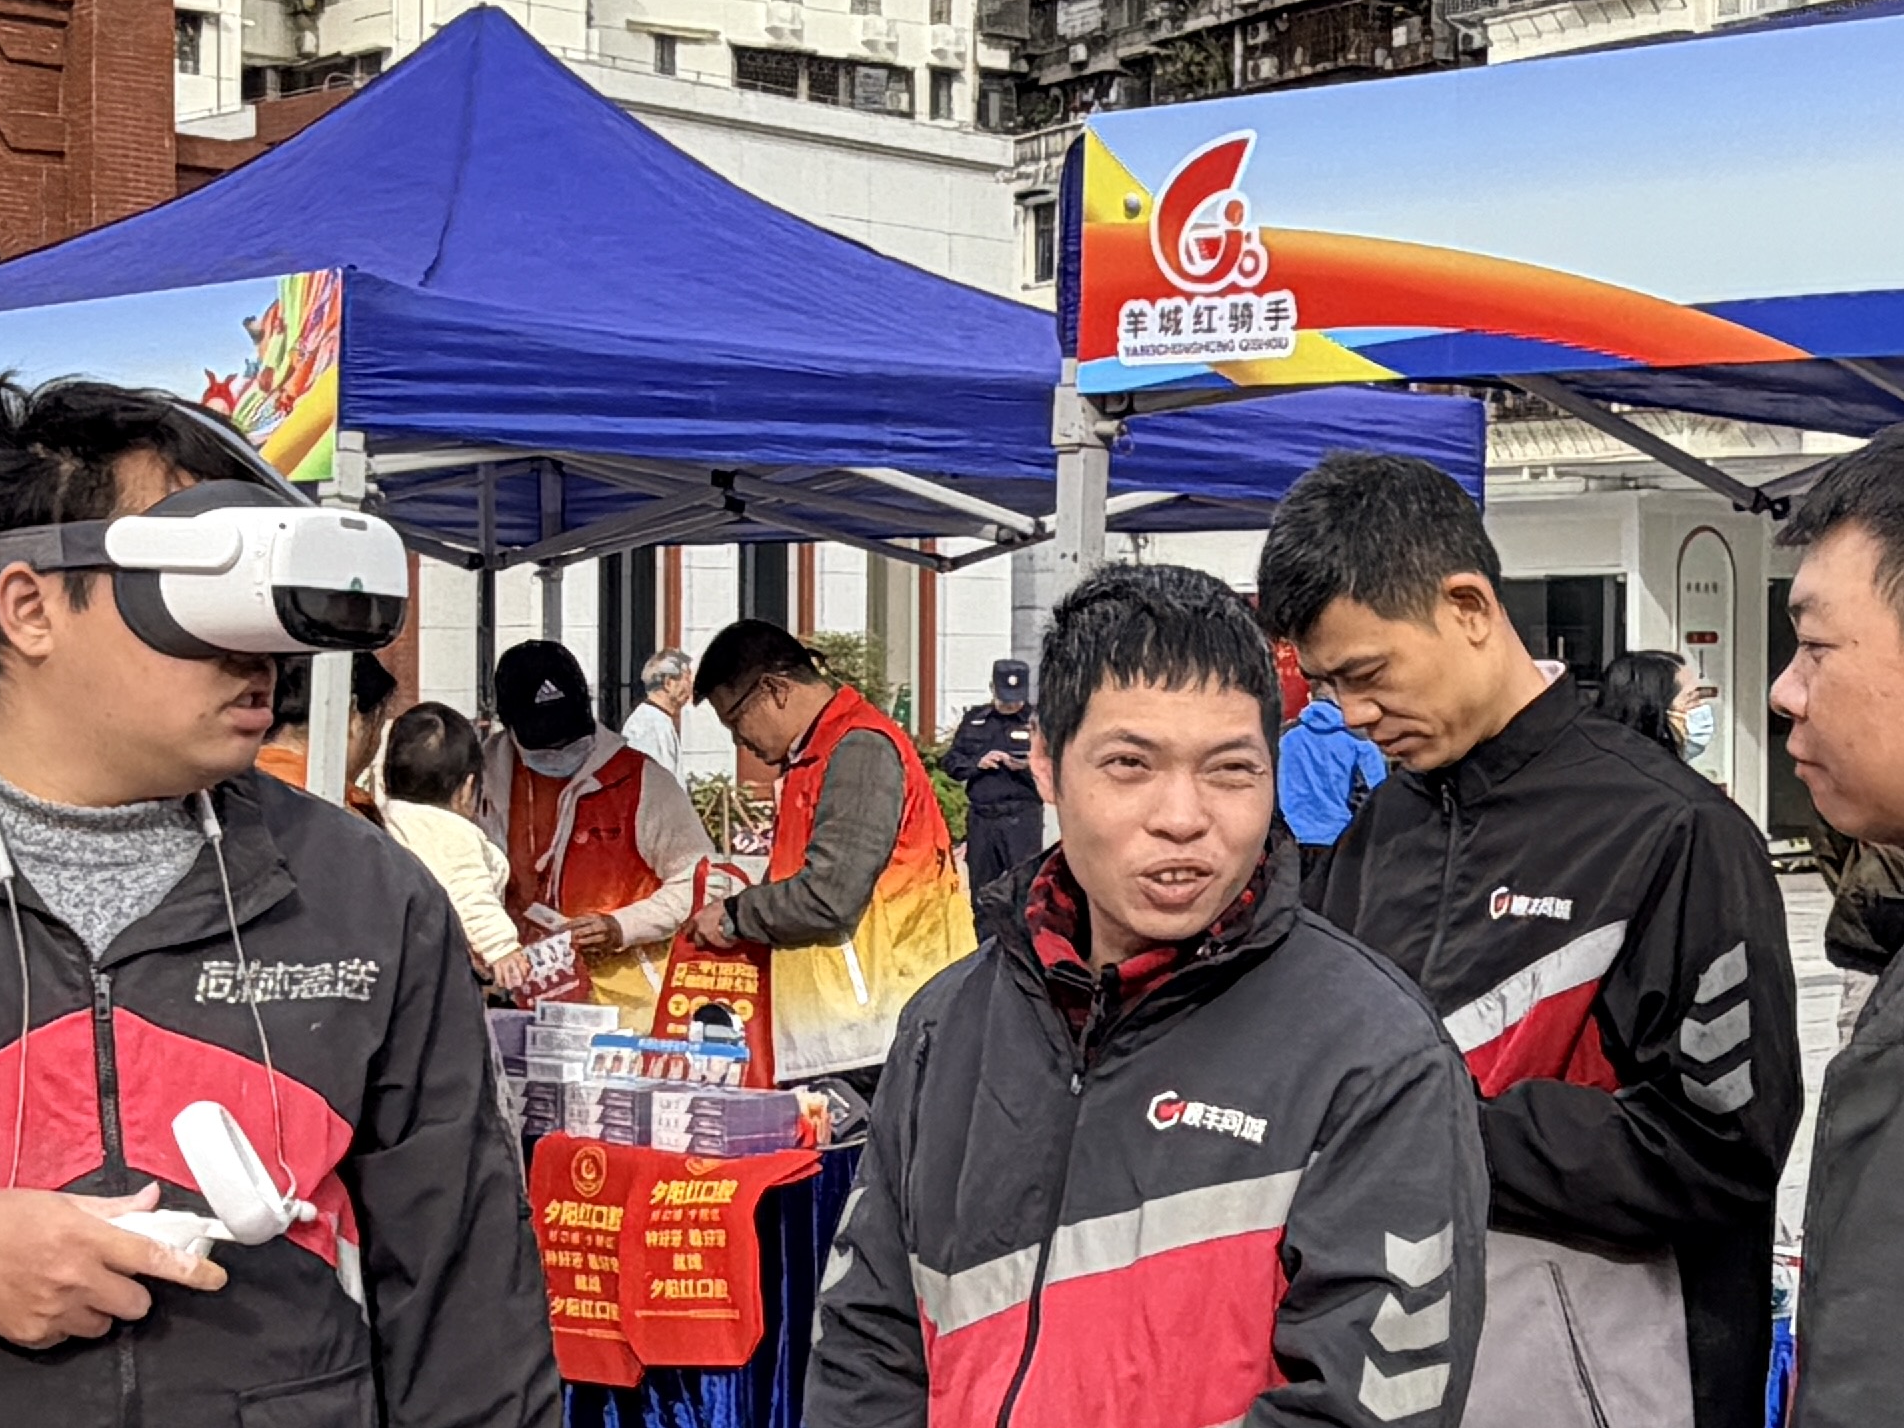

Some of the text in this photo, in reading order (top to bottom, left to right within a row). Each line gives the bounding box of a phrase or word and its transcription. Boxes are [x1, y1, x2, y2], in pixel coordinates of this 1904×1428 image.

[1123, 298, 1291, 339] 羊城红骑手
[1181, 1101, 1268, 1143] 顺丰同城
[648, 1179, 739, 1205] 夕阳红口腔
[544, 1199, 624, 1232] 夕阳红口腔
